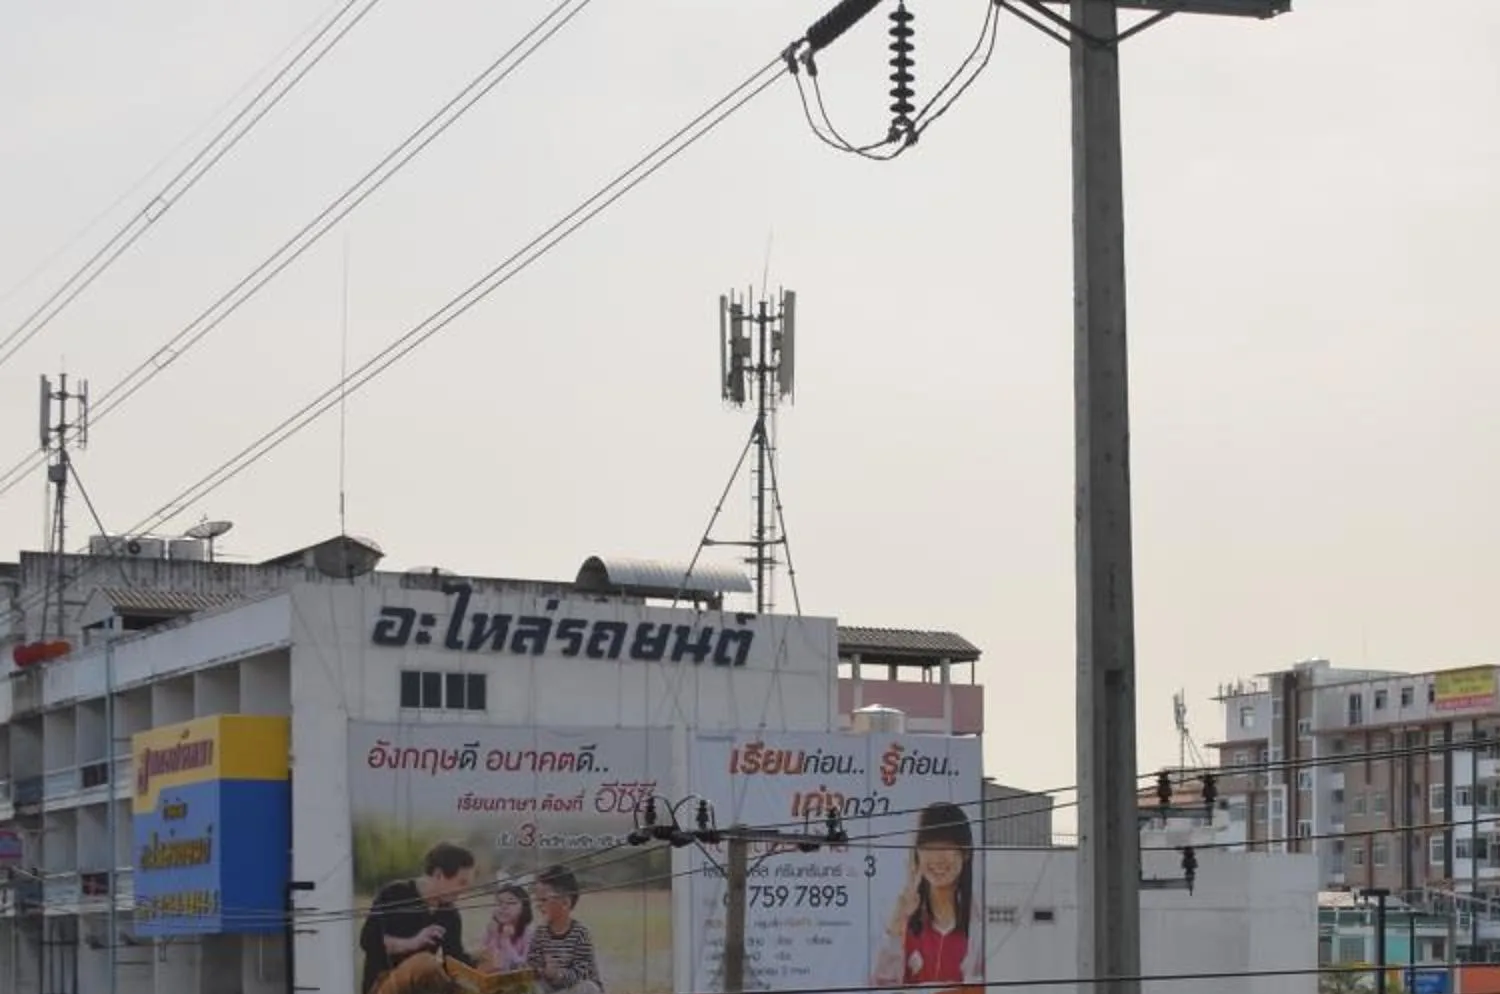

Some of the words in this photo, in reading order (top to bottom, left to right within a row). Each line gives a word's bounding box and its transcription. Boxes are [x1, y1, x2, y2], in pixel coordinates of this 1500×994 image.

[371, 581, 756, 667] อะไหล่รถยนต์
[367, 740, 480, 776] อังกฤษดี
[517, 823, 537, 848] 3
[864, 855, 877, 878] 3
[749, 886, 788, 908] 759
[795, 885, 848, 908] 7895
